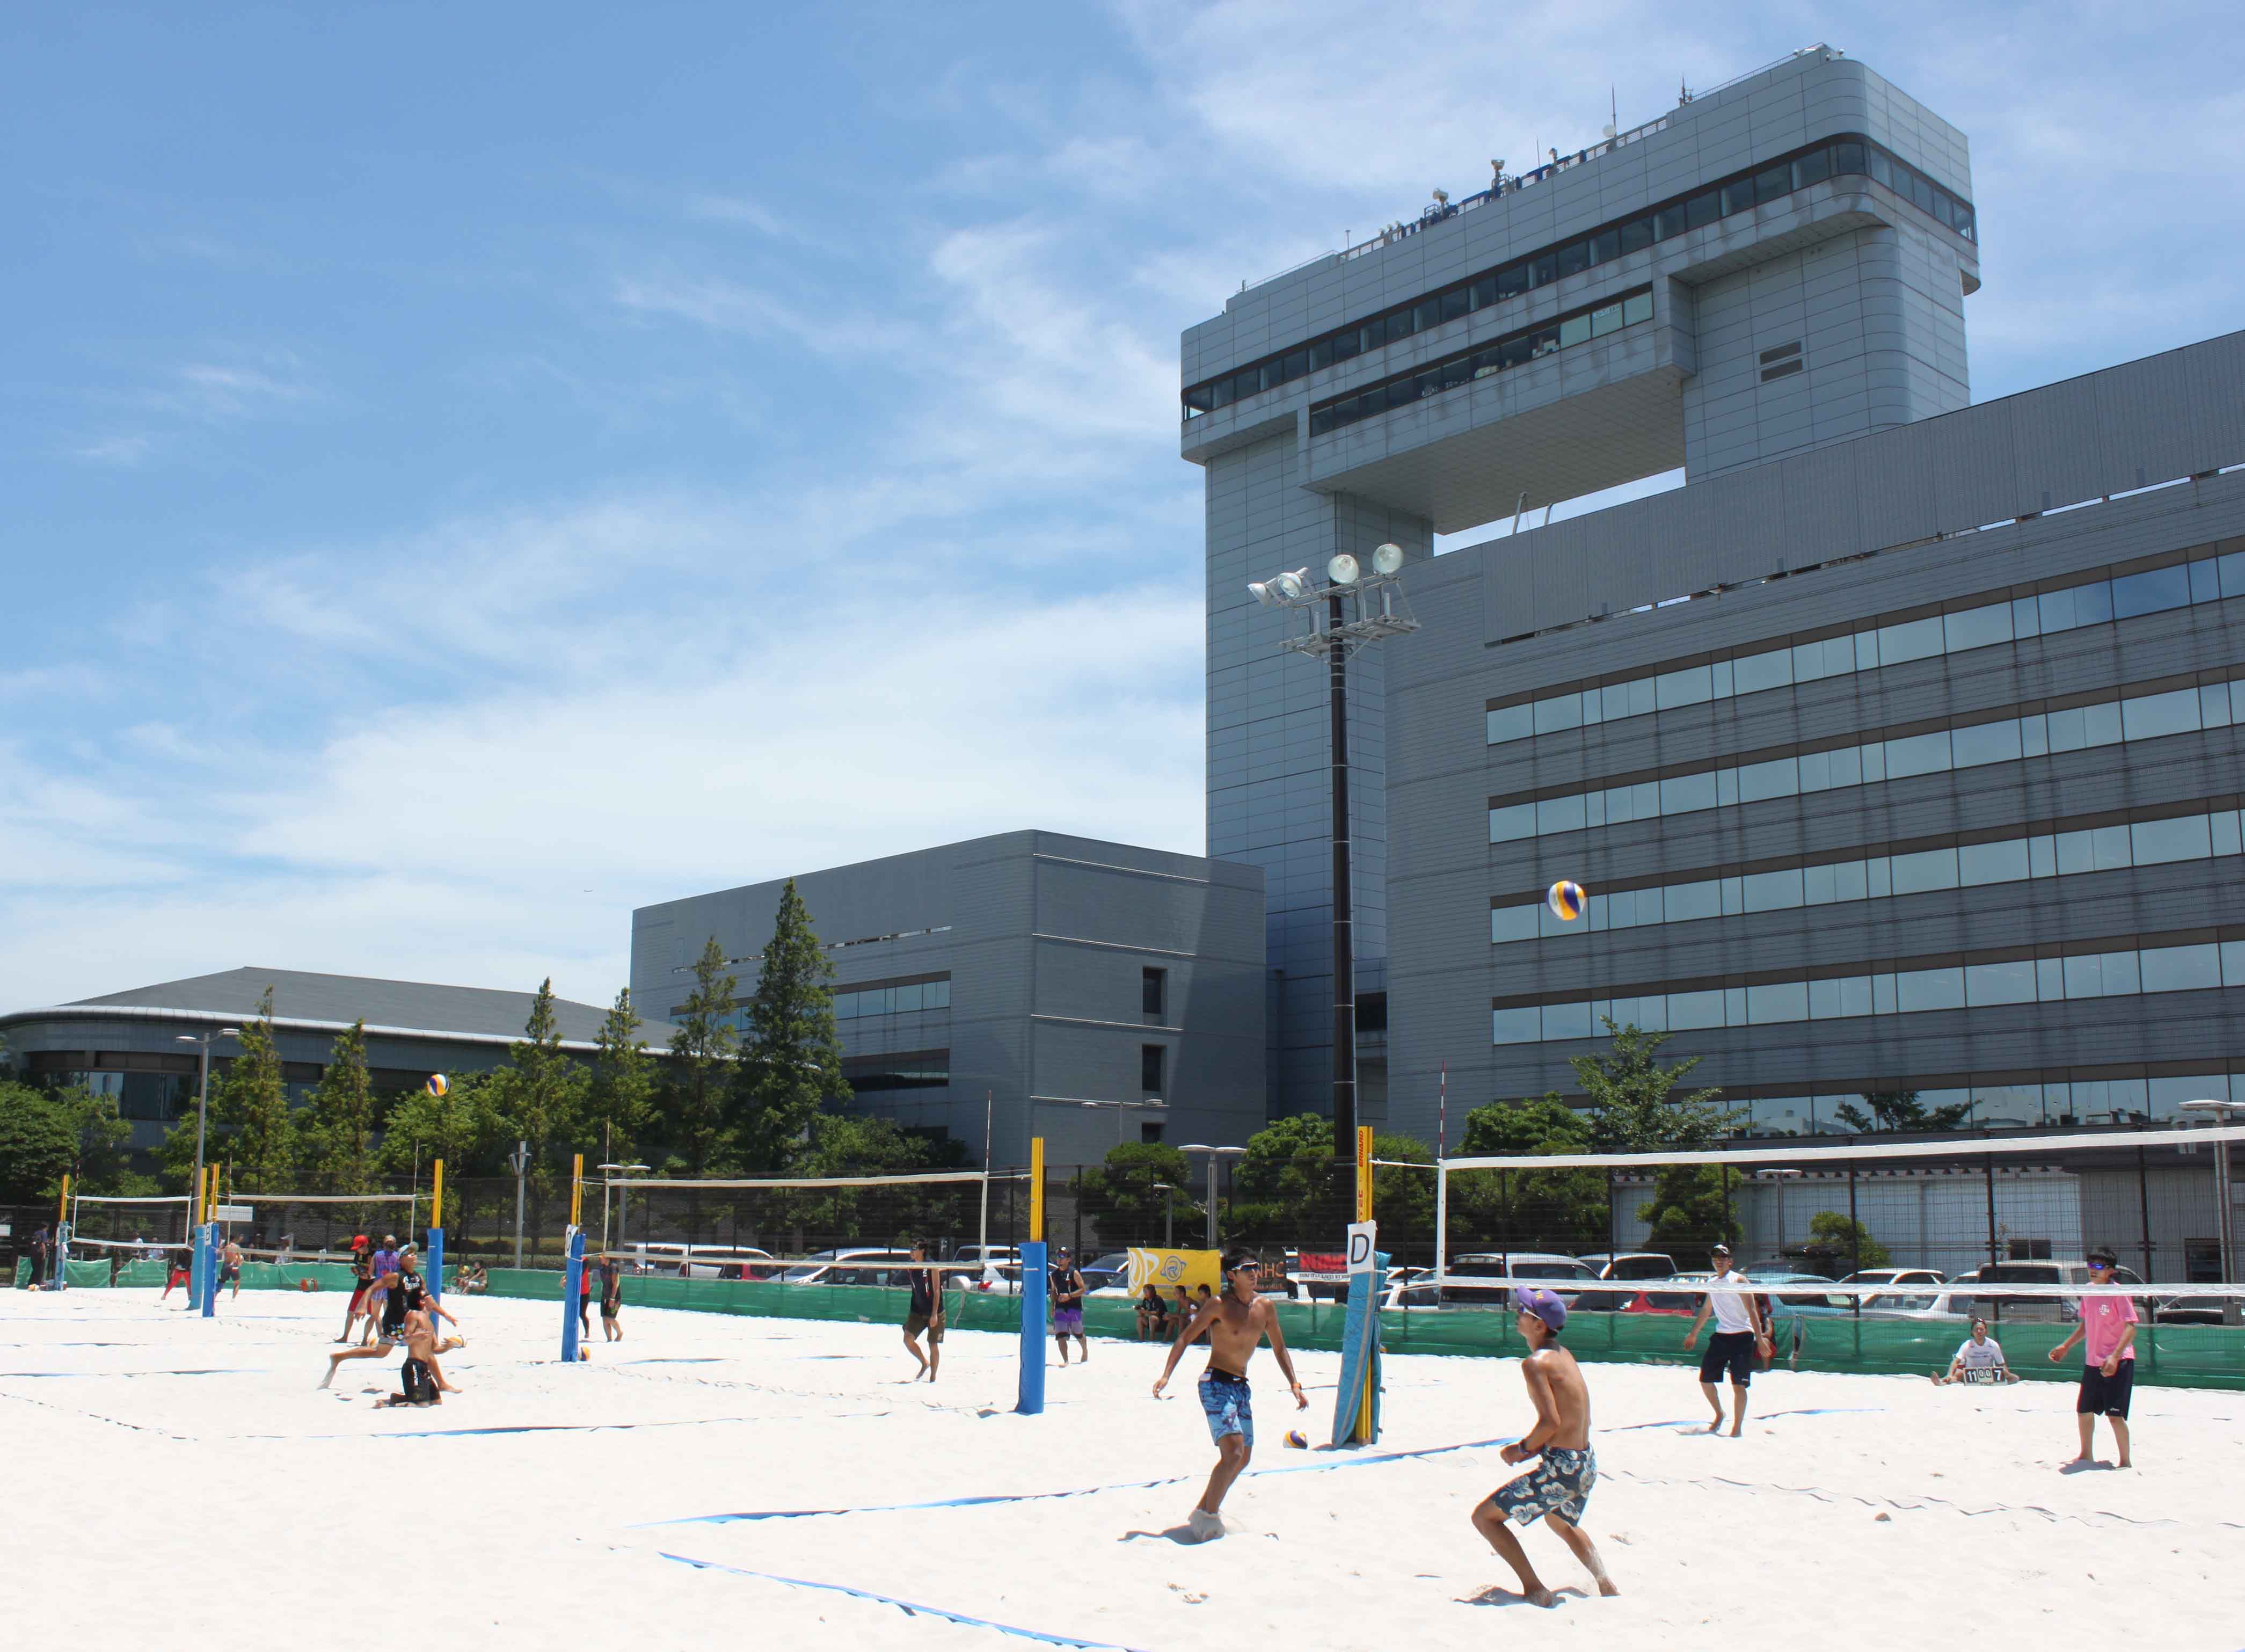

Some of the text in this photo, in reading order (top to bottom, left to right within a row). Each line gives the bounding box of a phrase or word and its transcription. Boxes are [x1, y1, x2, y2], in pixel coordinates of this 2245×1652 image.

[1351, 1234, 1369, 1264] D
[1966, 1371, 1978, 1382] 11
[1994, 1370, 2002, 1382] 7
